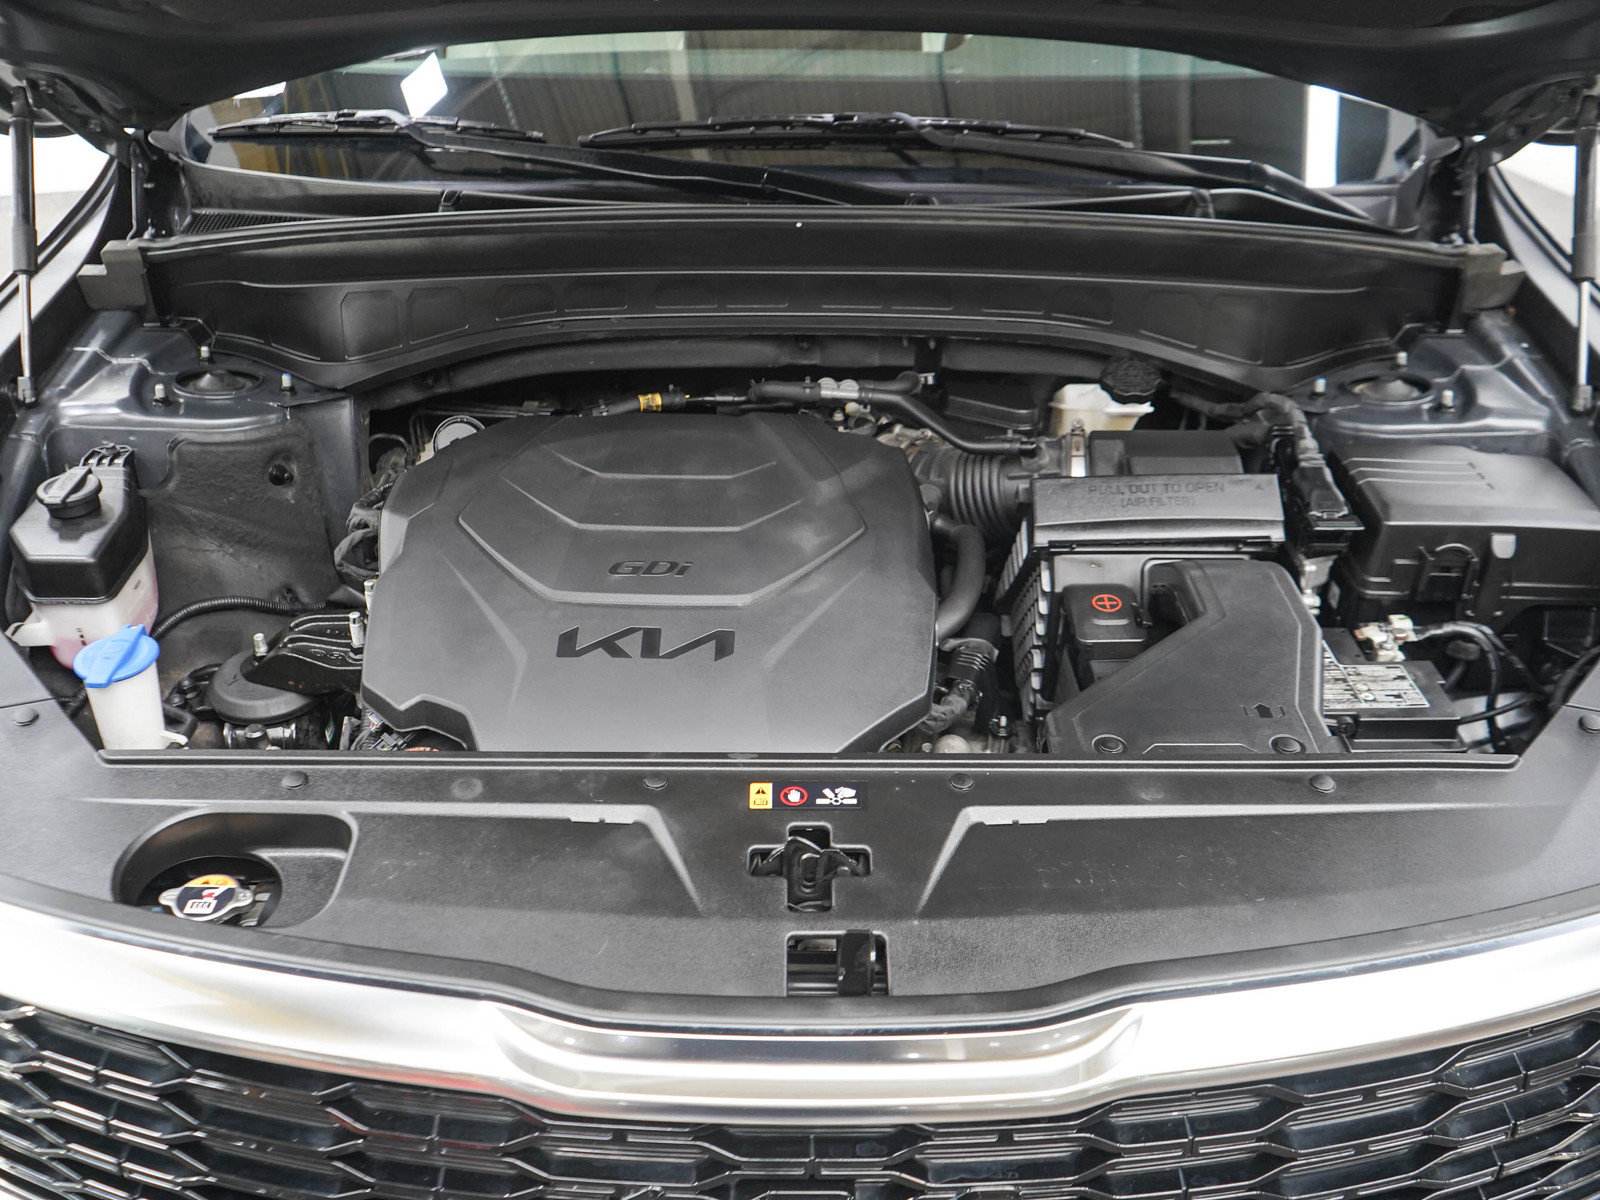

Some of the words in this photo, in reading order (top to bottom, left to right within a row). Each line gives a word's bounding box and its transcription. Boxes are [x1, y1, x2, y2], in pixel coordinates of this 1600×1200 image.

[1088, 484, 1125, 496] PULL
[1129, 483, 1159, 495] OUT
[1165, 483, 1182, 494] TO
[1187, 482, 1225, 494] OPEN
[608, 560, 693, 578] GDi
[556, 625, 735, 662] KIA
